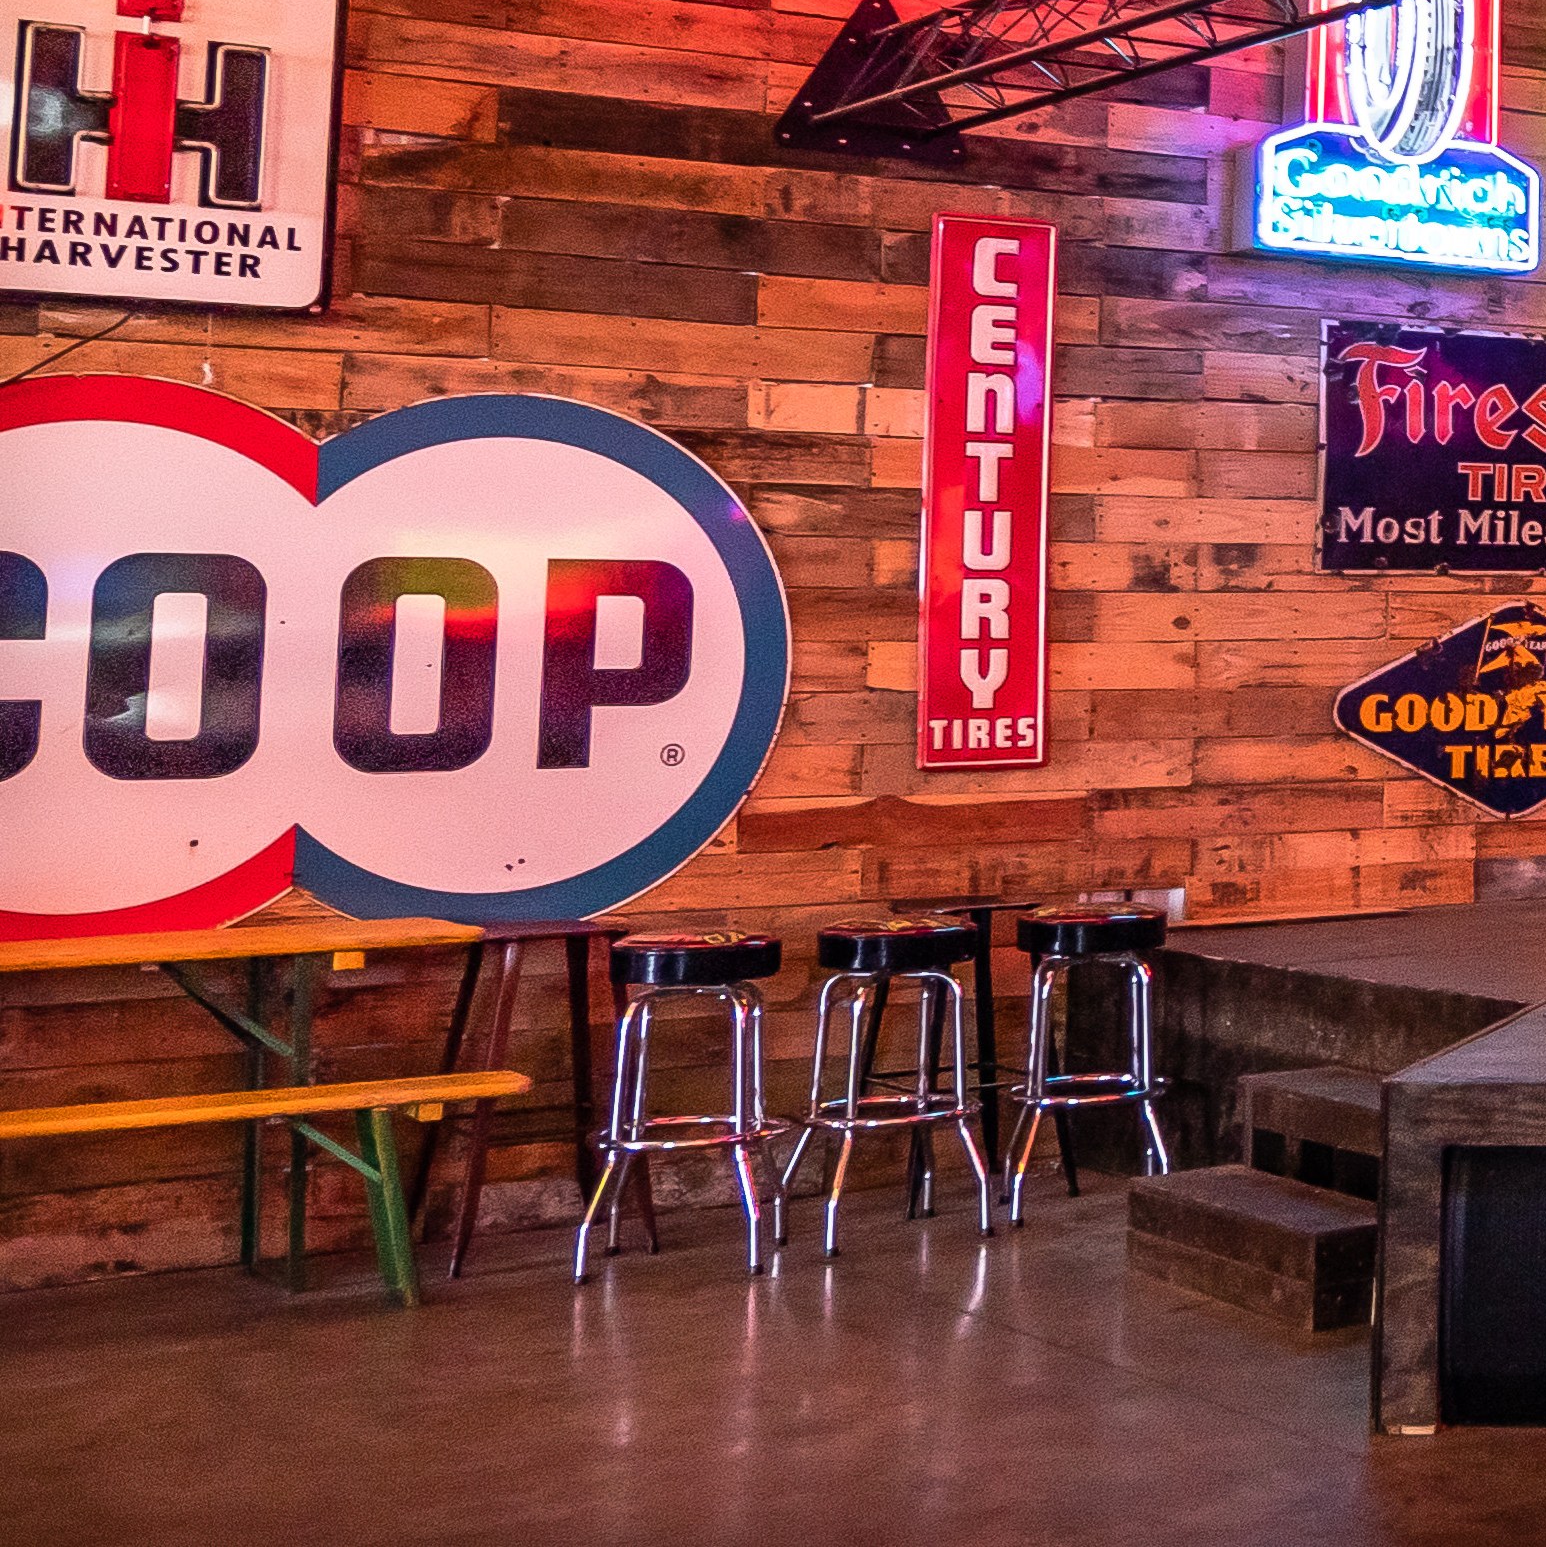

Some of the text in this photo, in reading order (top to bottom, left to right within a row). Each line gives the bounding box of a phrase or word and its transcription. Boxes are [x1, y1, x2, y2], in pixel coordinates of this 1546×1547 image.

[1275, 146, 1527, 216] Goodrich
[0, 204, 303, 253] TERNATIONAL
[0, 235, 263, 280] HARVESTER
[1338, 506, 1443, 546] Most
[928, 715, 1036, 751] TIRES
